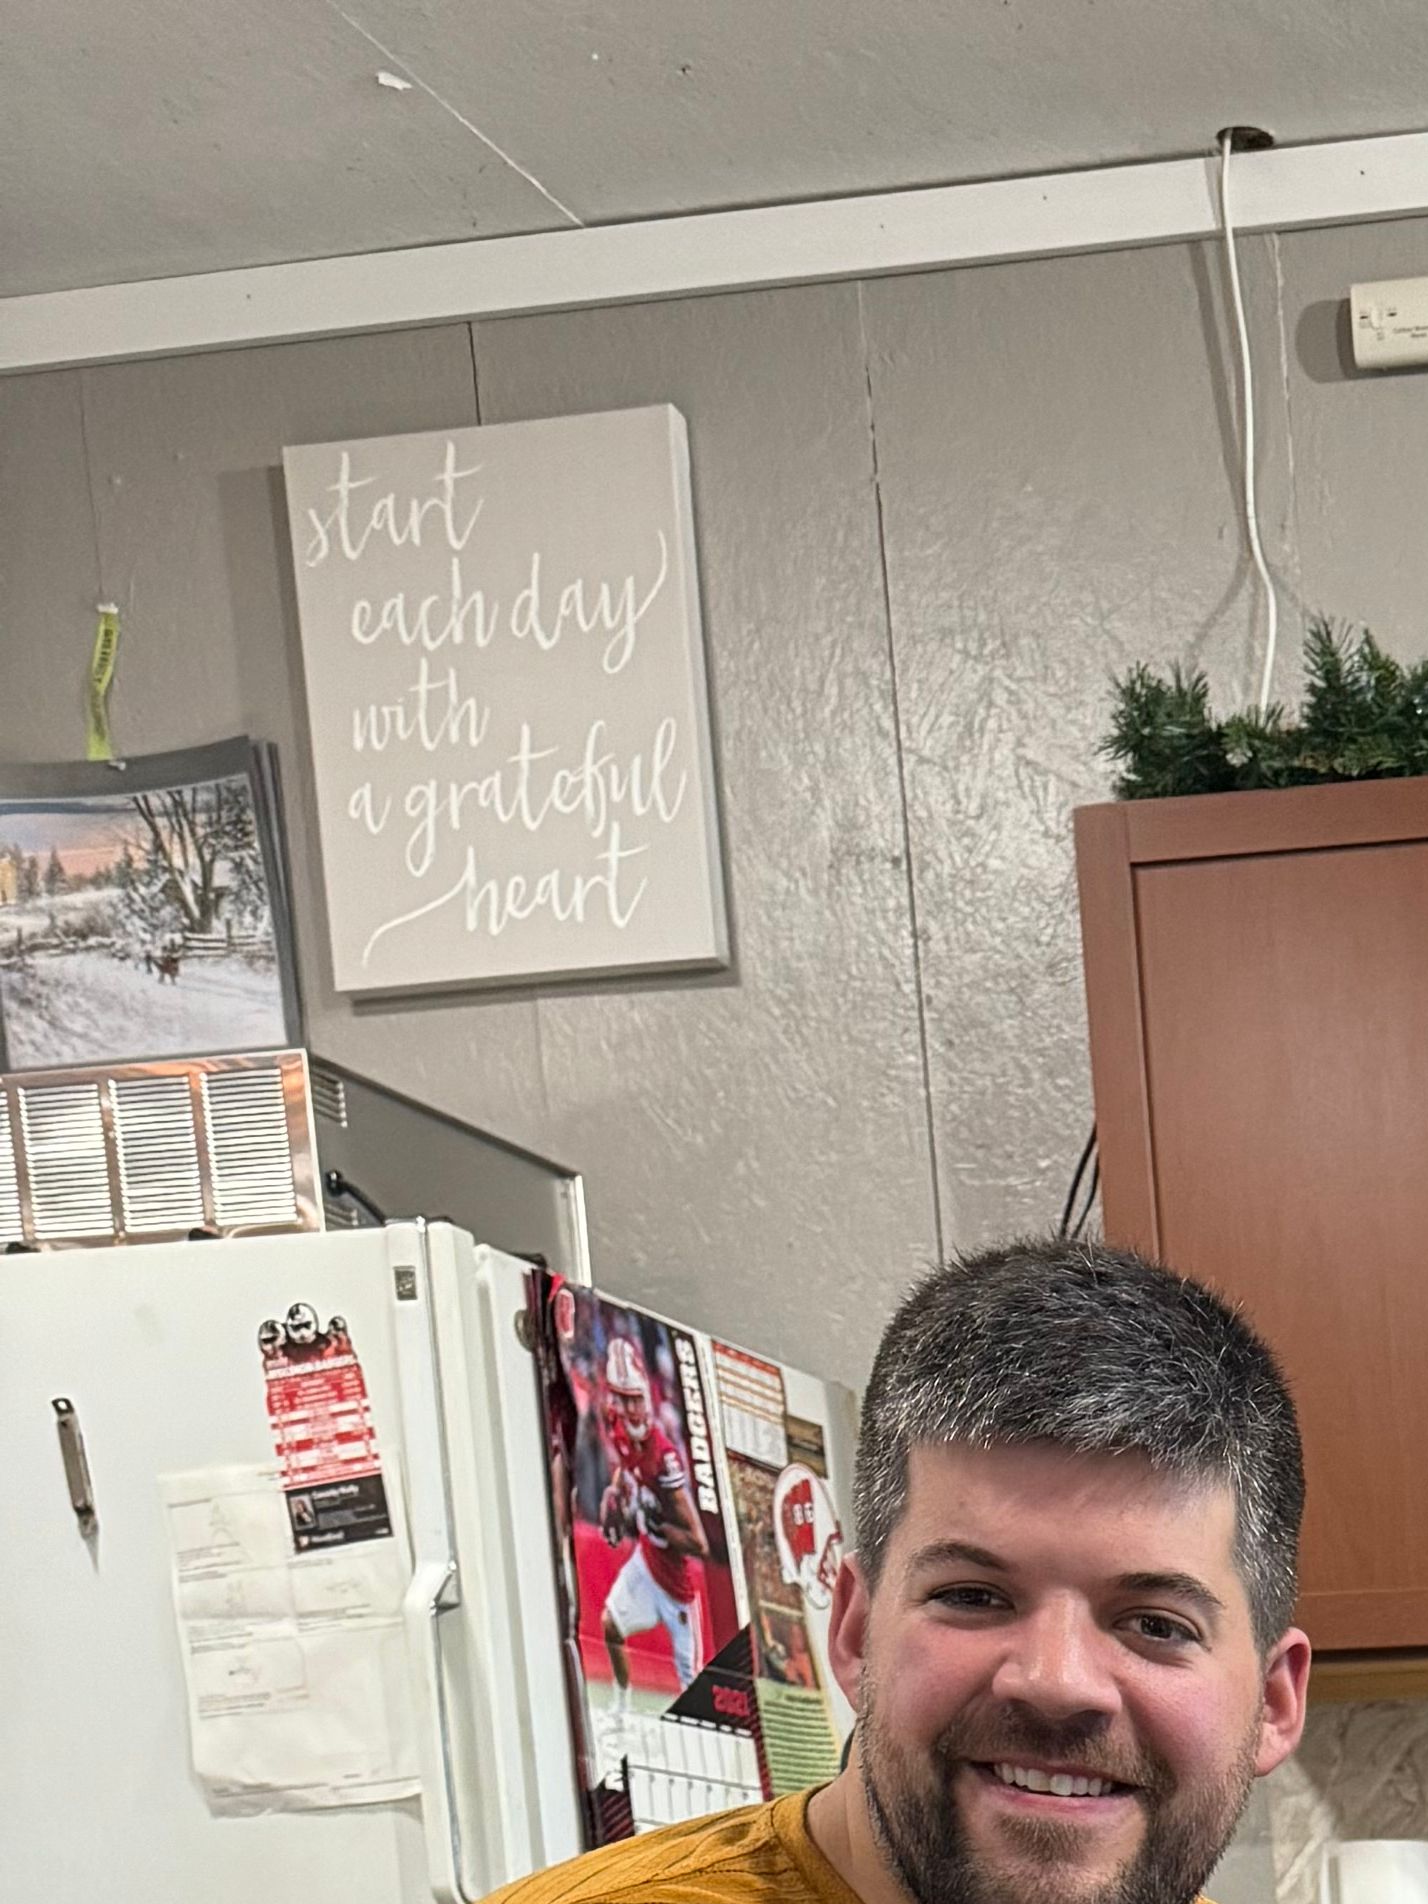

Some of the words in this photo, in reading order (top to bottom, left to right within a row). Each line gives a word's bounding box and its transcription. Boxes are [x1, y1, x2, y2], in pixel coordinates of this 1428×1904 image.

[306, 441, 485, 567] start
[351, 557, 499, 648] each
[510, 530, 667, 674] day
[353, 658, 490, 752] with
[348, 783, 393, 834] a
[405, 718, 688, 877] grateful
[362, 821, 648, 967] heart
[674, 1337, 719, 1514] BADGERS
